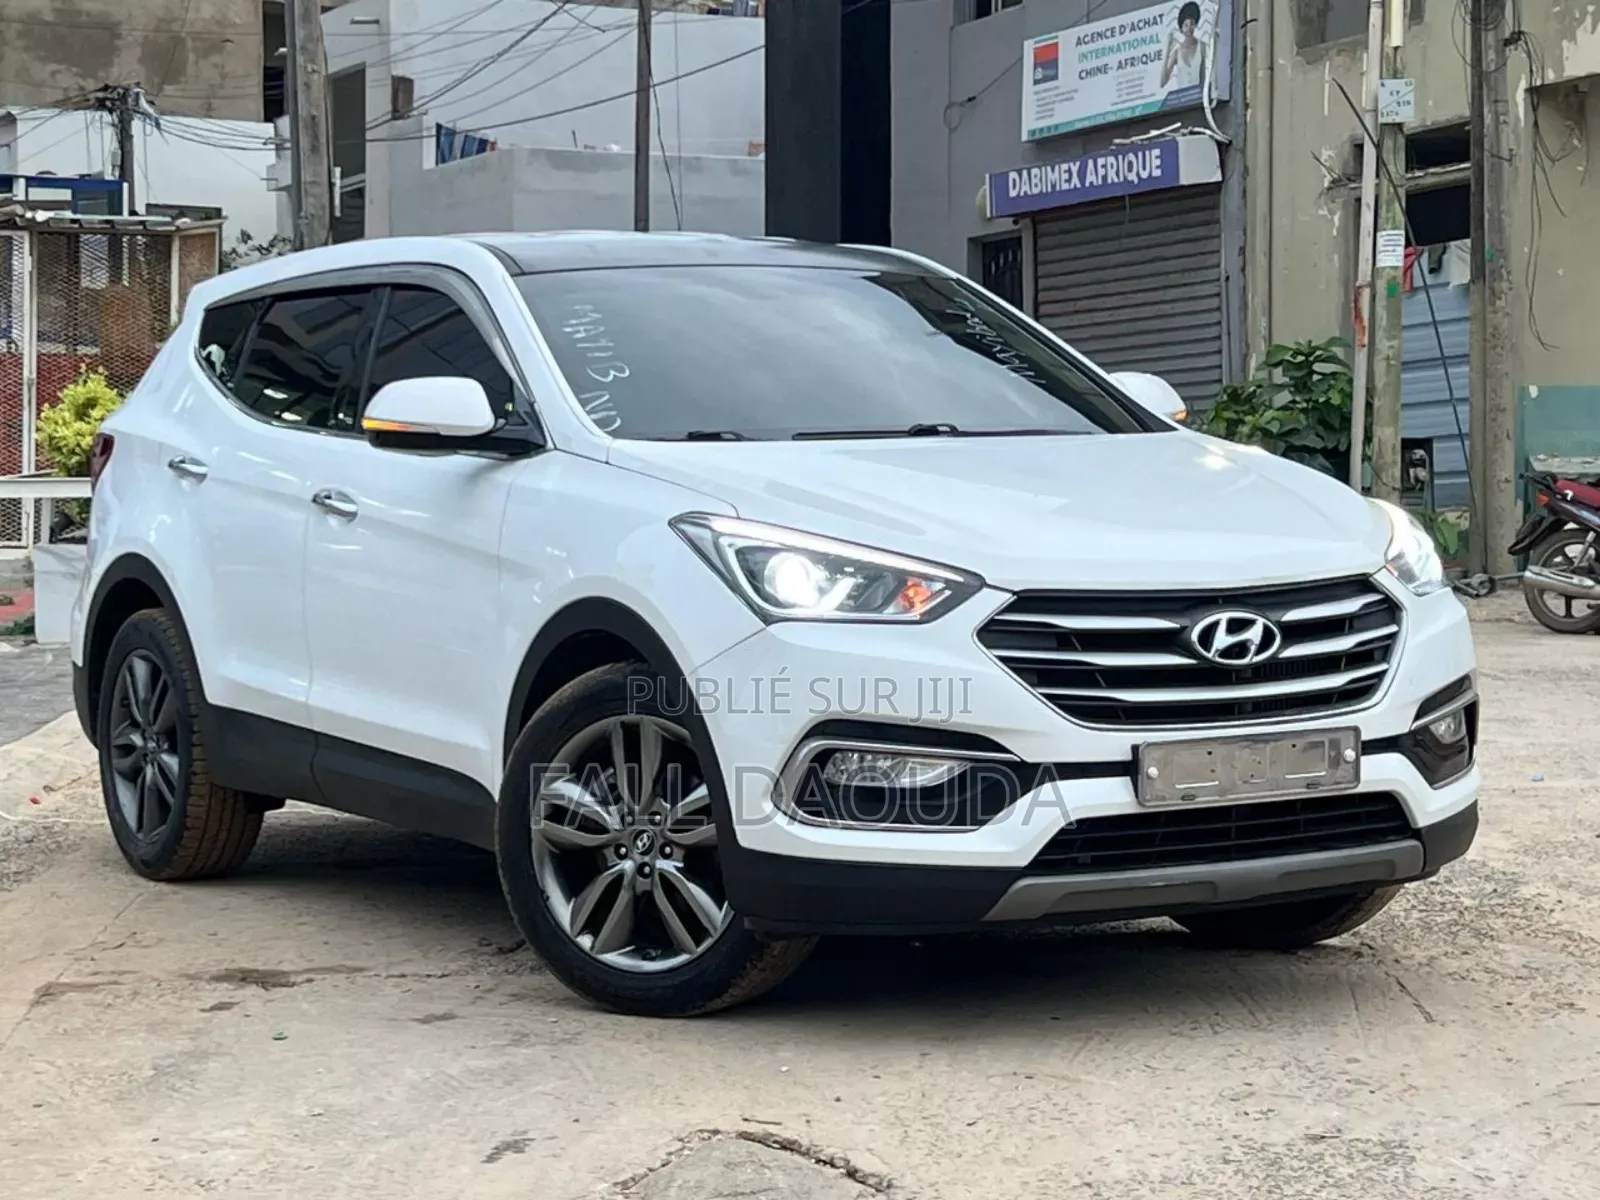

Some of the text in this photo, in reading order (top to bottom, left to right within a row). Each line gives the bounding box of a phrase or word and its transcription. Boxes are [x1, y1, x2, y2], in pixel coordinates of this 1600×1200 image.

[1075, 13, 1165, 47] AGENCE D'ACHAT
[1078, 32, 1162, 63] INTERNATIONAL
[1116, 49, 1163, 71] AFRIQUE
[1008, 148, 1162, 198] DABIMEX AFRIQUE
